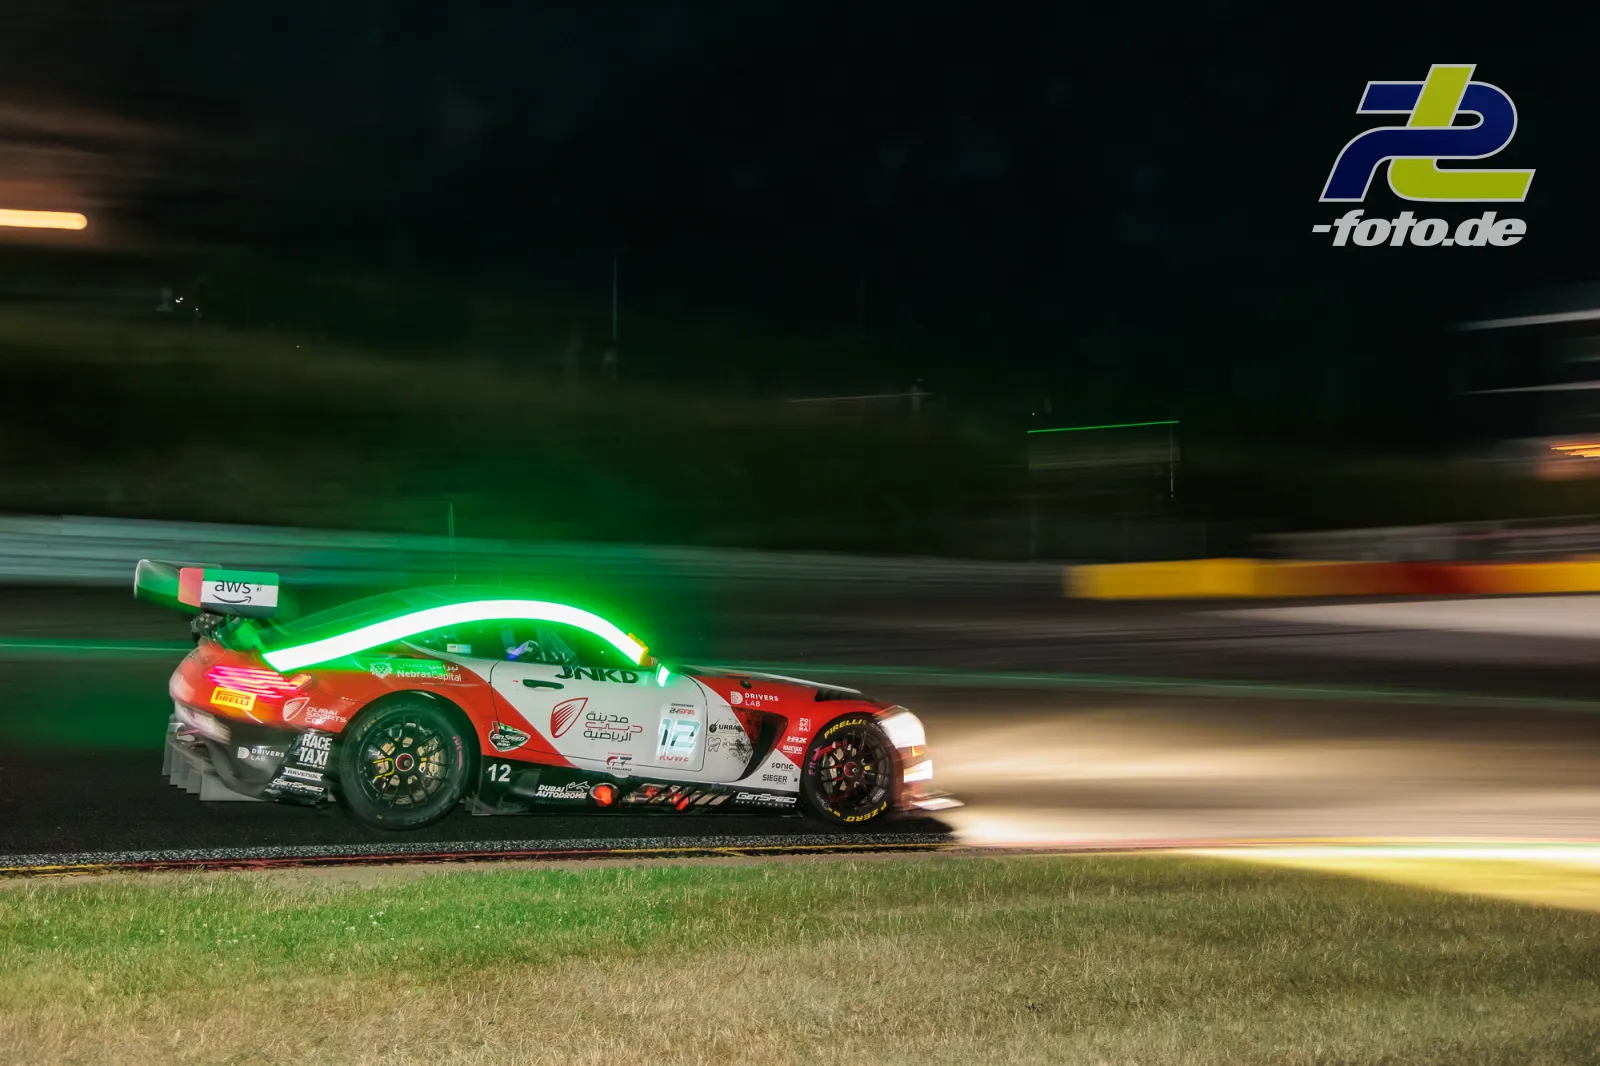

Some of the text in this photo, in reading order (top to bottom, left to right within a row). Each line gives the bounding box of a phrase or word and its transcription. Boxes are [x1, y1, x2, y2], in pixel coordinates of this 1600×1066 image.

[214, 580, 252, 594] aws
[554, 666, 640, 684] JNKD
[214, 690, 251, 706] PIRELLI
[744, 692, 779, 702] DRIVERS
[306, 711, 347, 723] SPORTS
[307, 706, 338, 716] DUBAI
[586, 711, 629, 724] مدينة
[585, 721, 643, 733] دبي
[823, 719, 863, 739] PIRELLI
[301, 733, 333, 751] RACE
[583, 729, 632, 742] الرياضية
[658, 718, 701, 757] 12
[251, 748, 285, 758] DRIVERS
[299, 746, 330, 766] TAXI
[487, 763, 511, 782] 12
[762, 774, 787, 783] SIEGER
[535, 790, 588, 799] AUTODROME
[537, 784, 565, 793] DUBAI
[844, 808, 879, 822] ZERO
